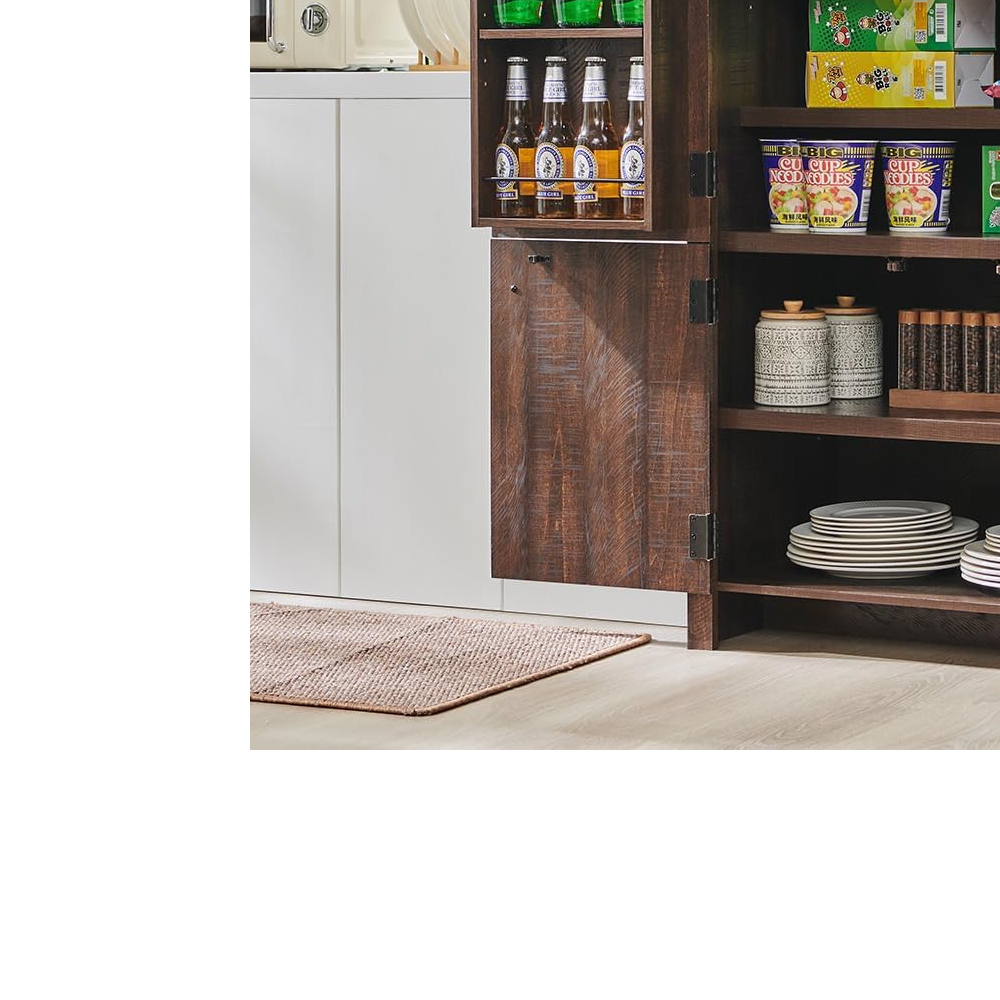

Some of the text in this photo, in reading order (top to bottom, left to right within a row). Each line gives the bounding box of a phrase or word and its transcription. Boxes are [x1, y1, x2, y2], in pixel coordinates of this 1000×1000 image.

[778, 145, 800, 157] BI
[806, 147, 843, 158] BIG
[885, 147, 922, 158] BIG
[779, 157, 803, 171] CU
[809, 158, 842, 172] CUP
[889, 158, 921, 172] CUP
[769, 169, 803, 183] NOOD
[805, 170, 853, 185] NOODLES
[884, 170, 932, 185] NOODLES
